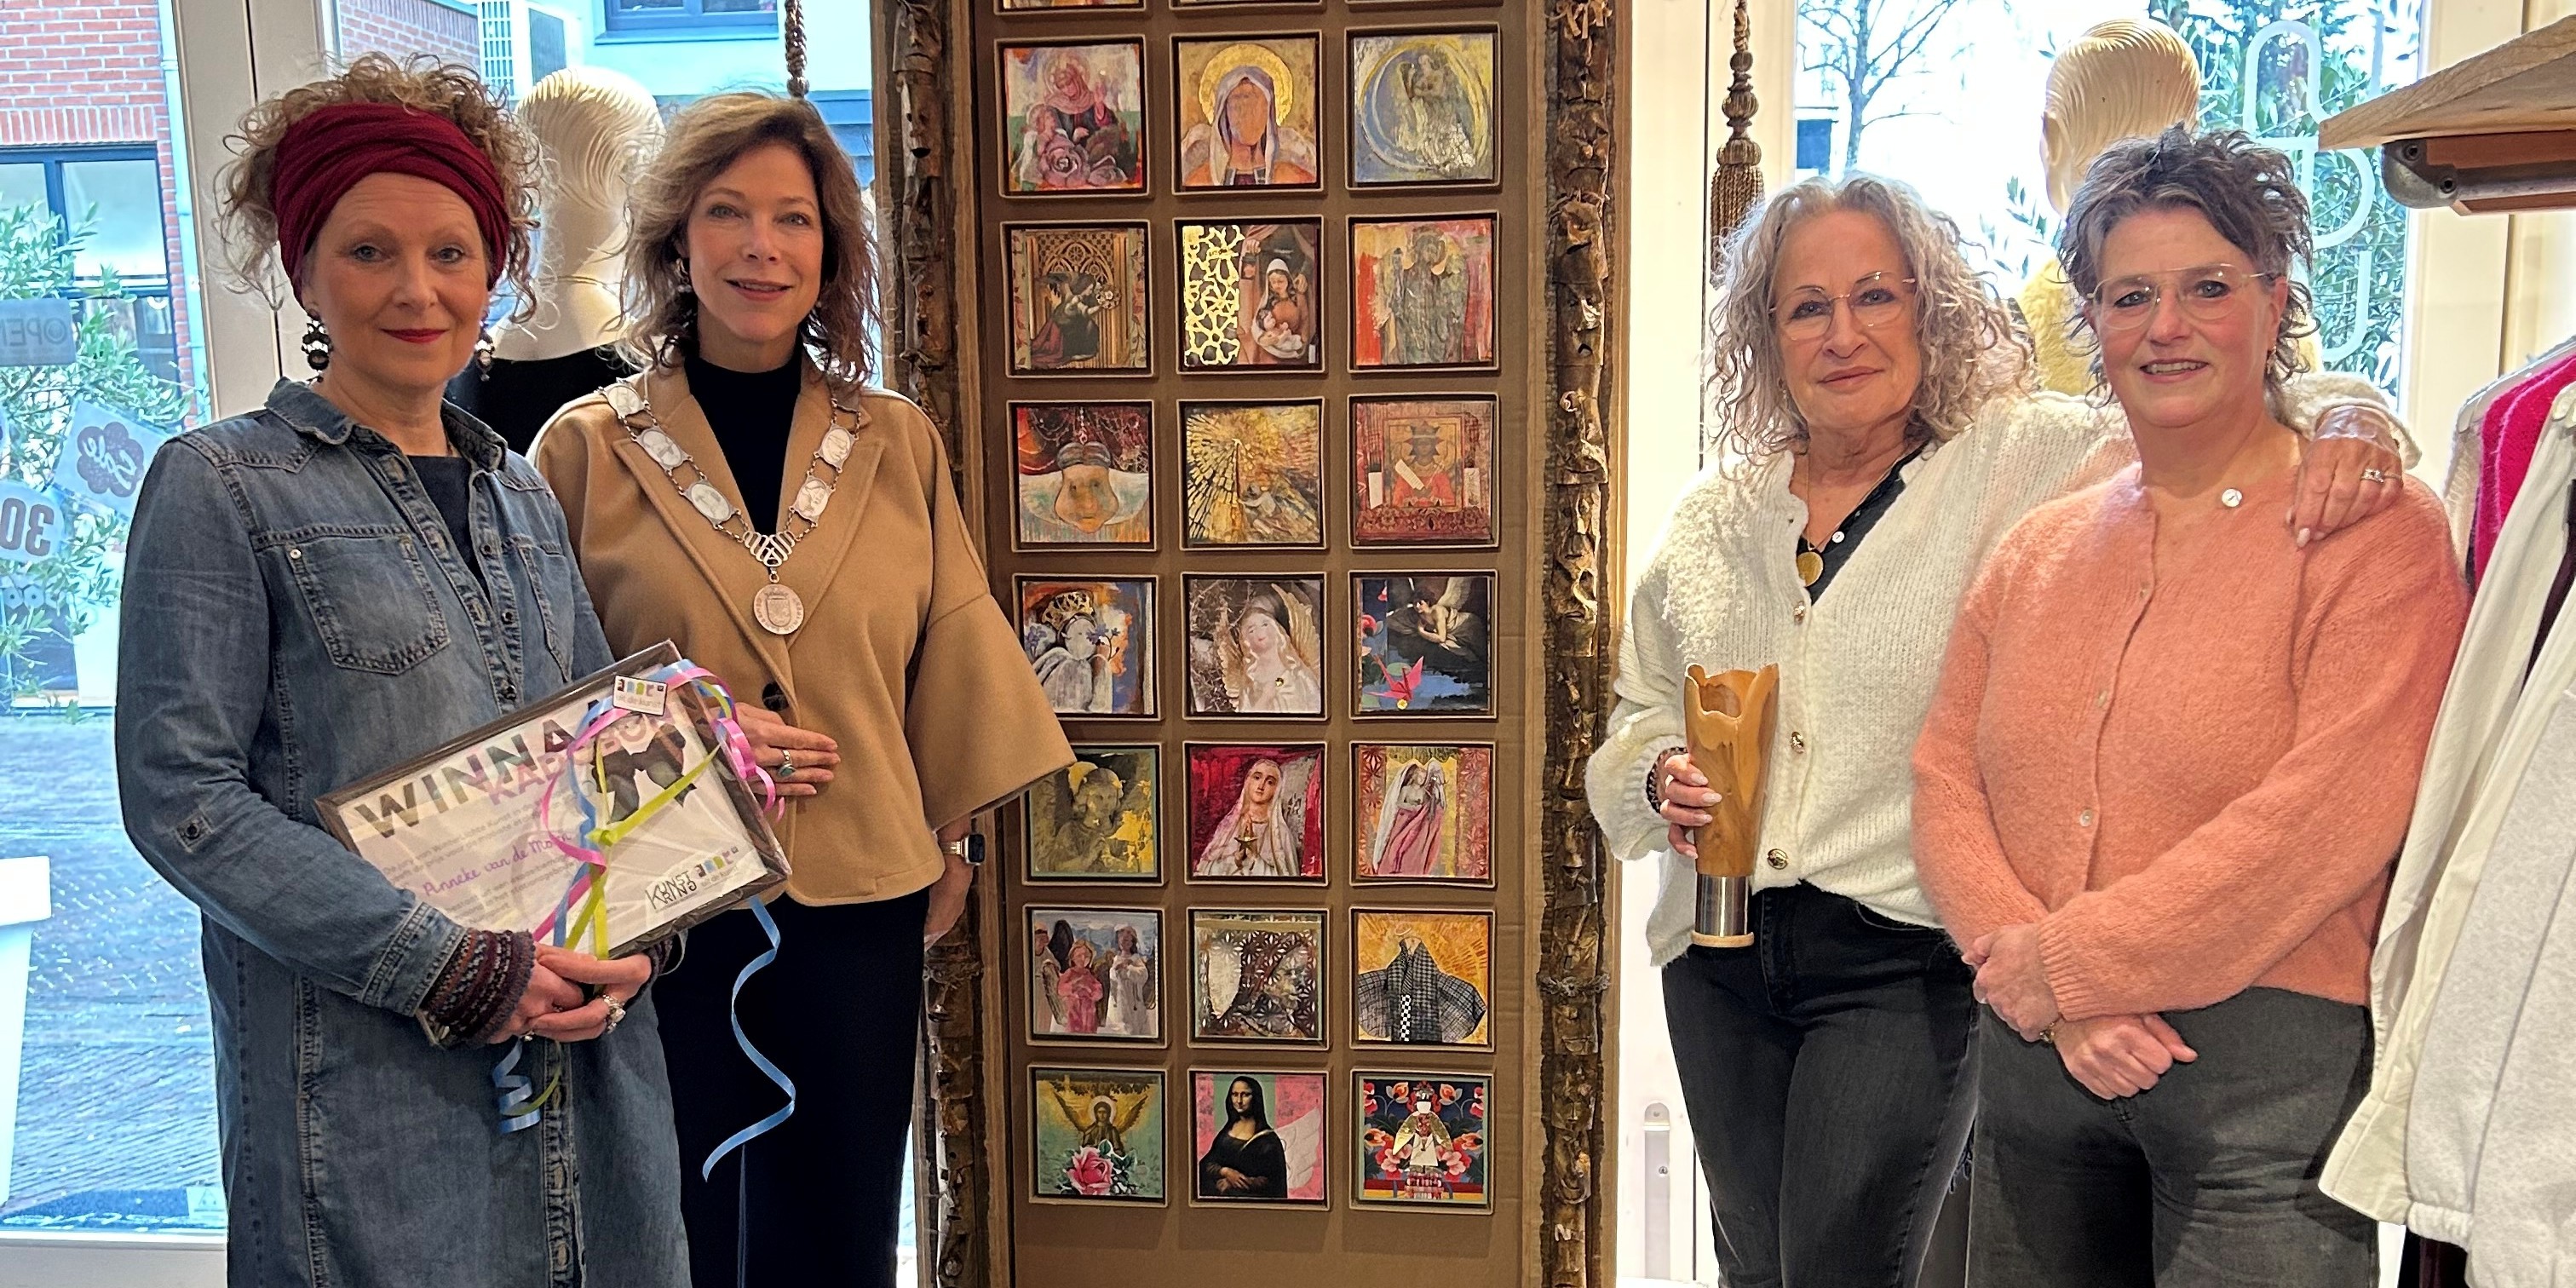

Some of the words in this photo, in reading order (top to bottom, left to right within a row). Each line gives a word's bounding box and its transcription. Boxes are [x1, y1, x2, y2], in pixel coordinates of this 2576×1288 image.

[422, 861, 481, 899] Anneke
[482, 854, 510, 873] van
[508, 841, 529, 863] de
